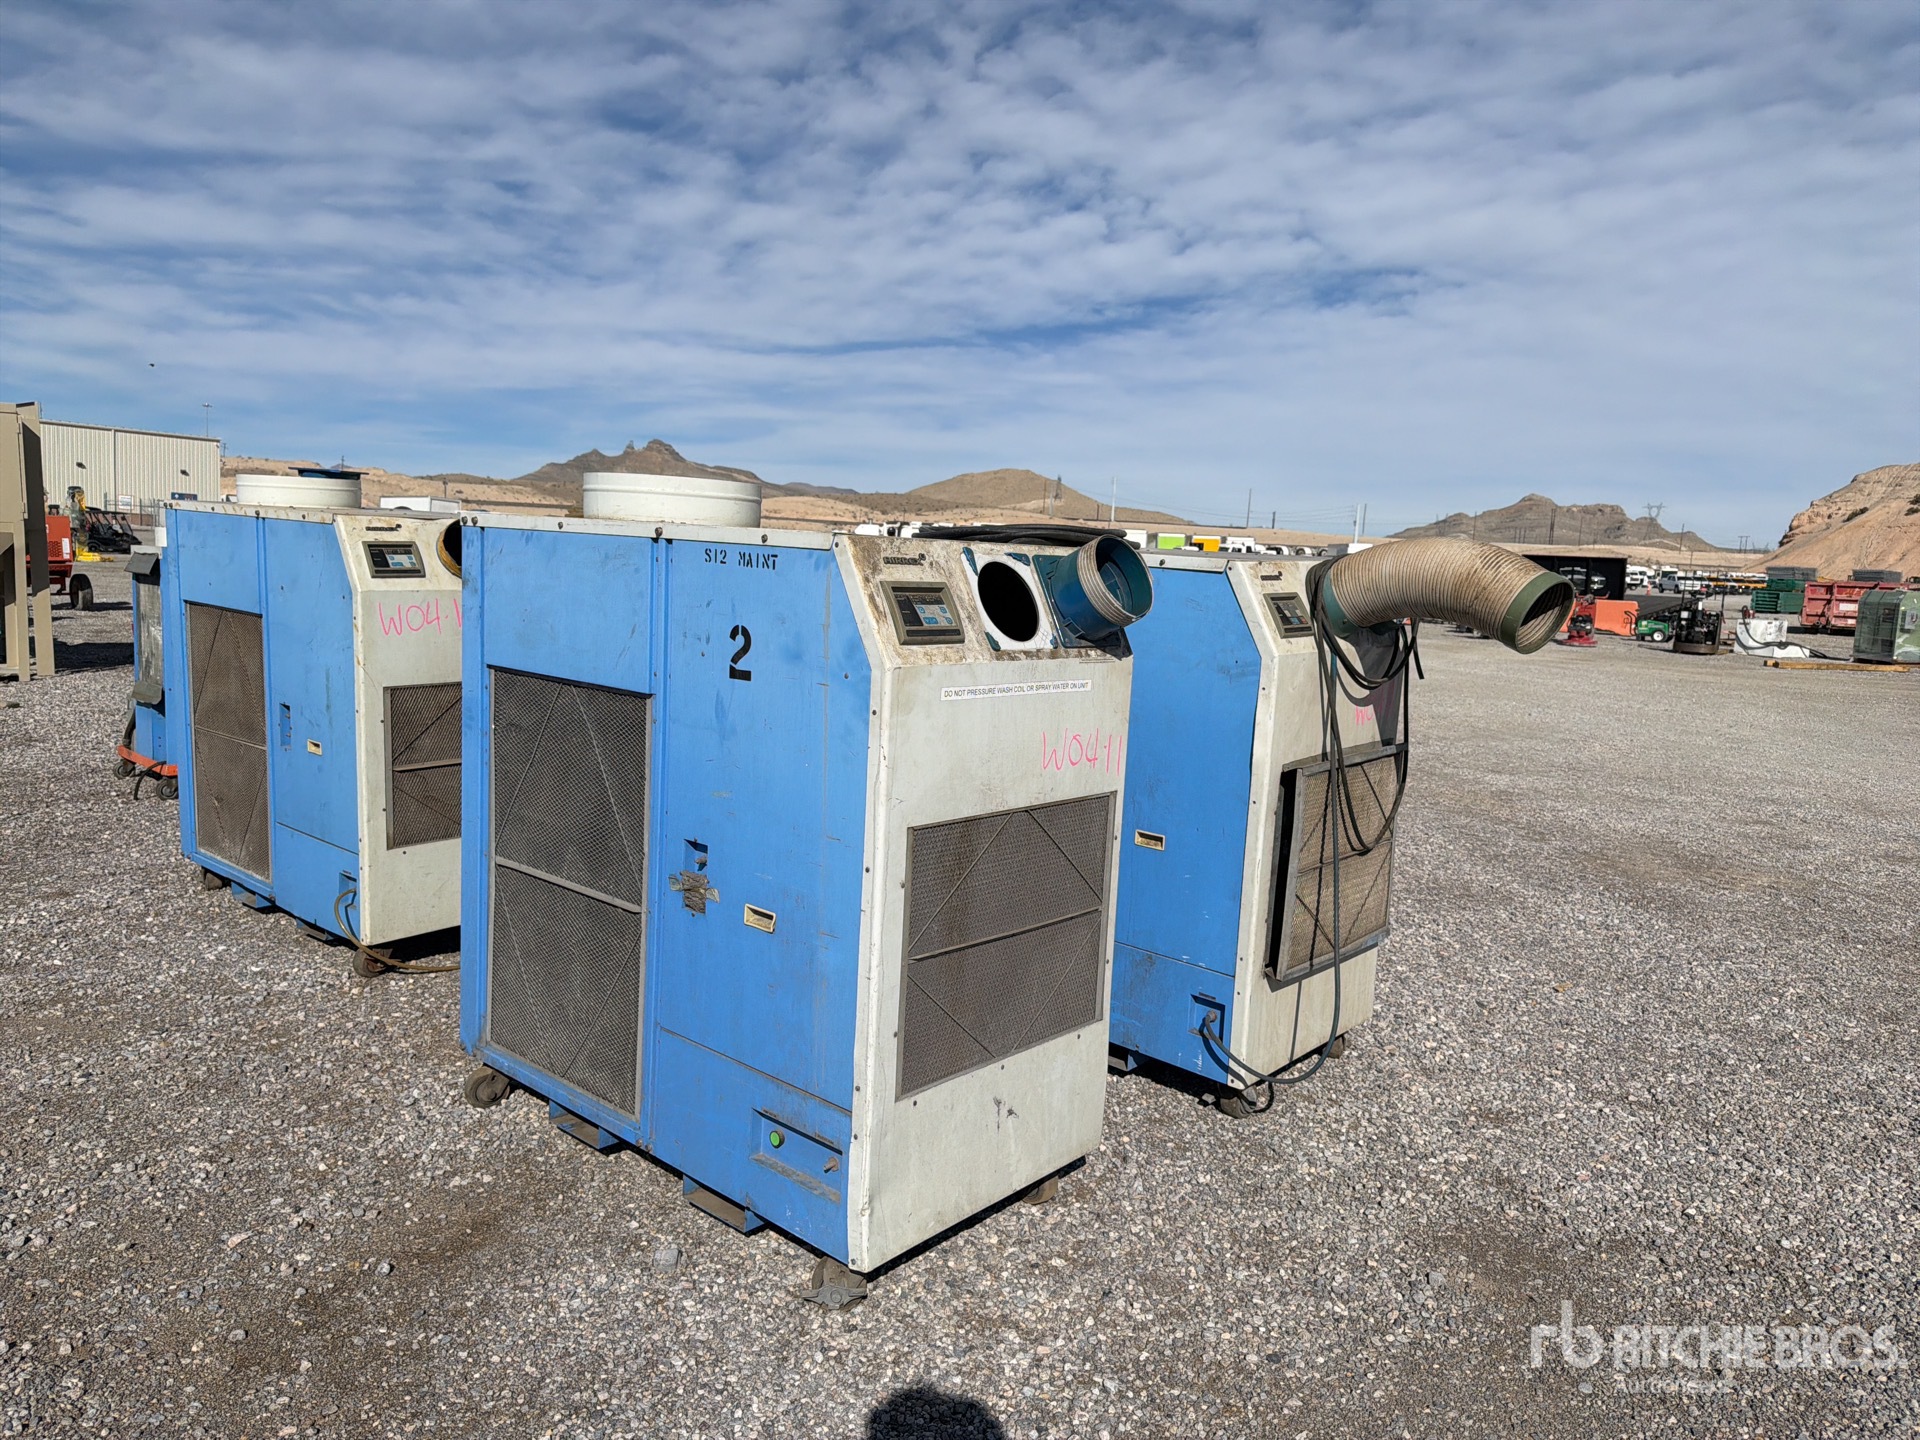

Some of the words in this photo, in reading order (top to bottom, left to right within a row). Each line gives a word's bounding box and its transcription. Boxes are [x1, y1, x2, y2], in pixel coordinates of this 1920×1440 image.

[738, 550, 779, 571] MAINT
[728, 624, 752, 682] 2
[944, 690, 953, 698] DO
[953, 689, 966, 697] NOT
[966, 687, 996, 696] PRESSURE
[997, 686, 1014, 694] WASH
[1013, 685, 1026, 693] COIL
[1034, 684, 1051, 692] SPRAY
